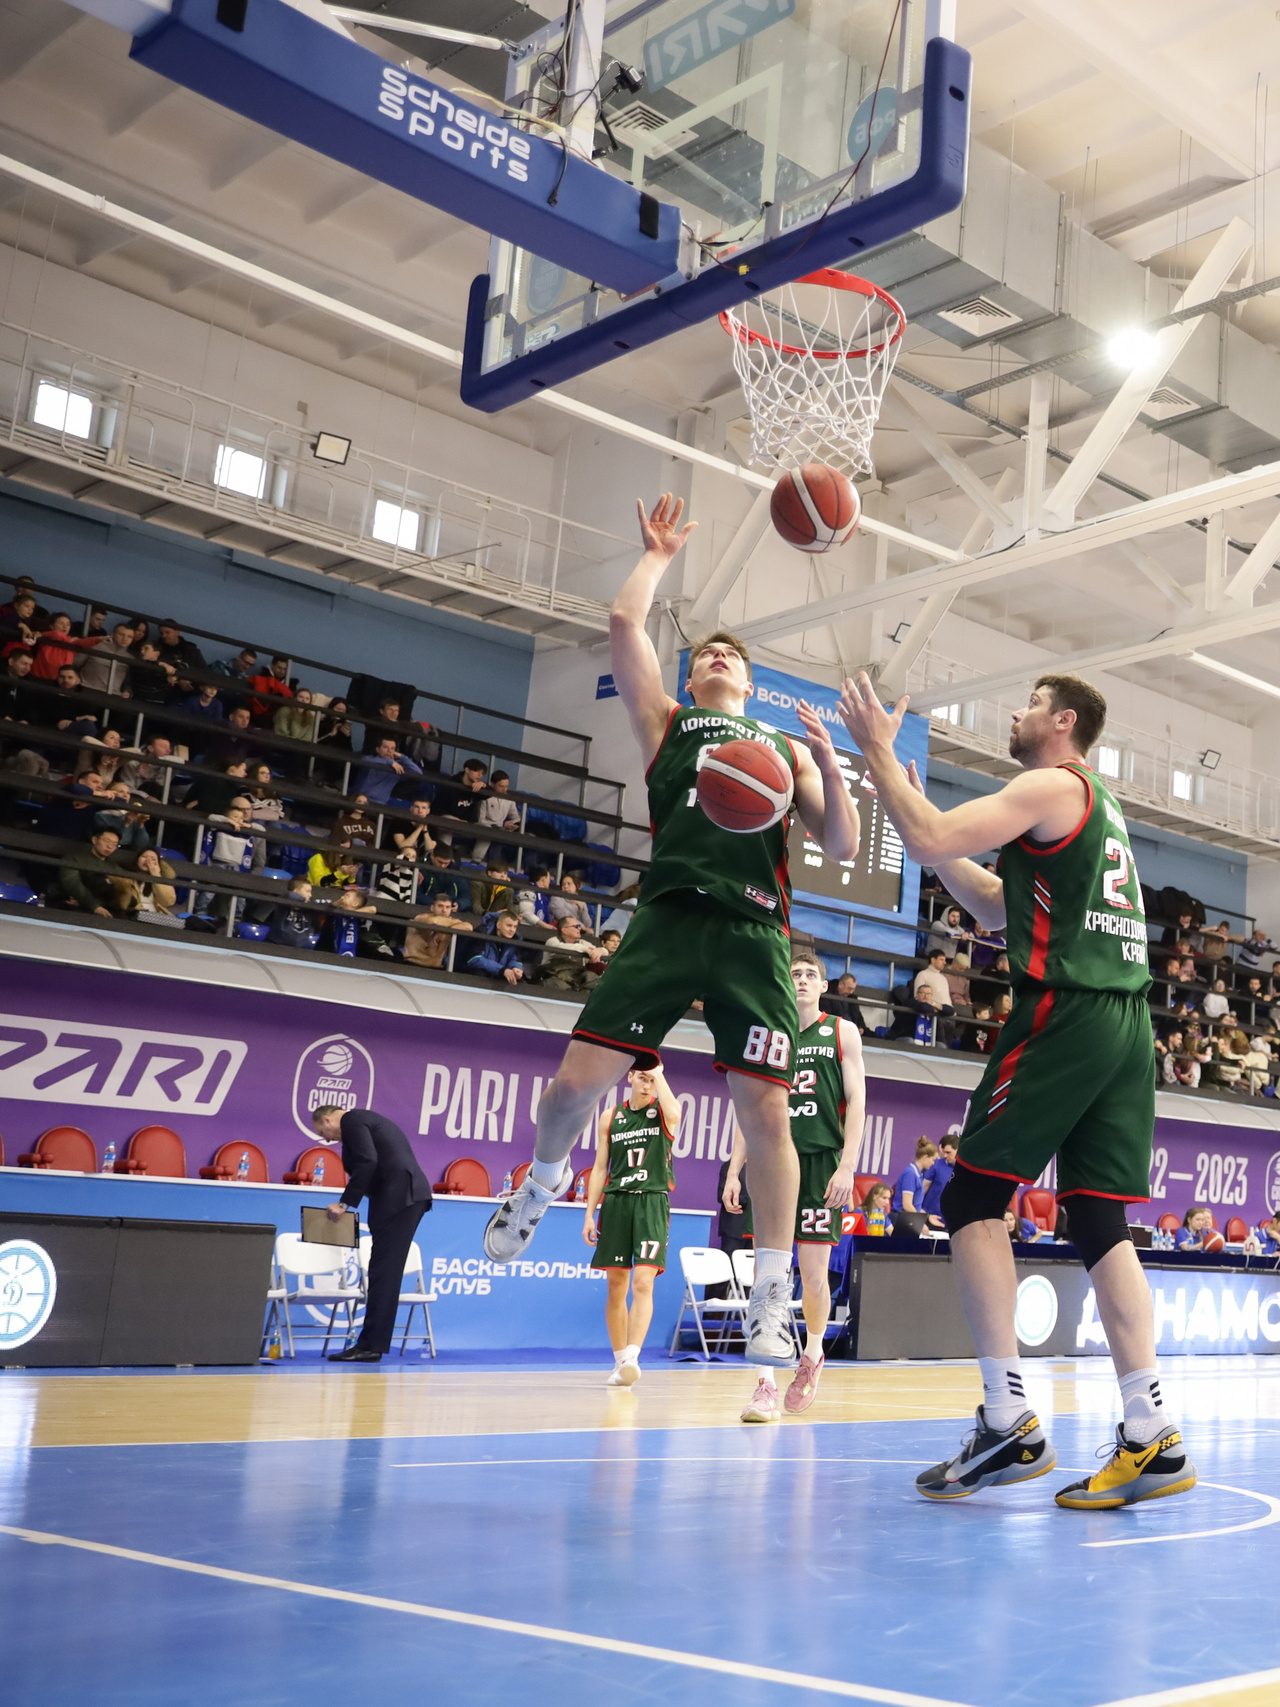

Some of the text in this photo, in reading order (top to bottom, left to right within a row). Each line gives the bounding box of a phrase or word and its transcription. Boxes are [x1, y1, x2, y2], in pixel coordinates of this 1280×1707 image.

[381, 68, 531, 160] Schelde
[378, 91, 528, 182] Sports
[757, 687, 847, 728] BCDYAM
[342, 824, 375, 836] UCLA
[743, 1025, 791, 1071] 88
[797, 1046, 835, 1059] МОТИВ
[320, 1079, 350, 1088] PARI
[418, 1063, 520, 1143] PARI
[611, 1126, 660, 1144] ЛОКОМОТИВ
[627, 1148, 647, 1168] 17
[801, 1208, 831, 1234] 22
[640, 1241, 661, 1260] 17
[430, 1278, 491, 1296] КЛУБ
